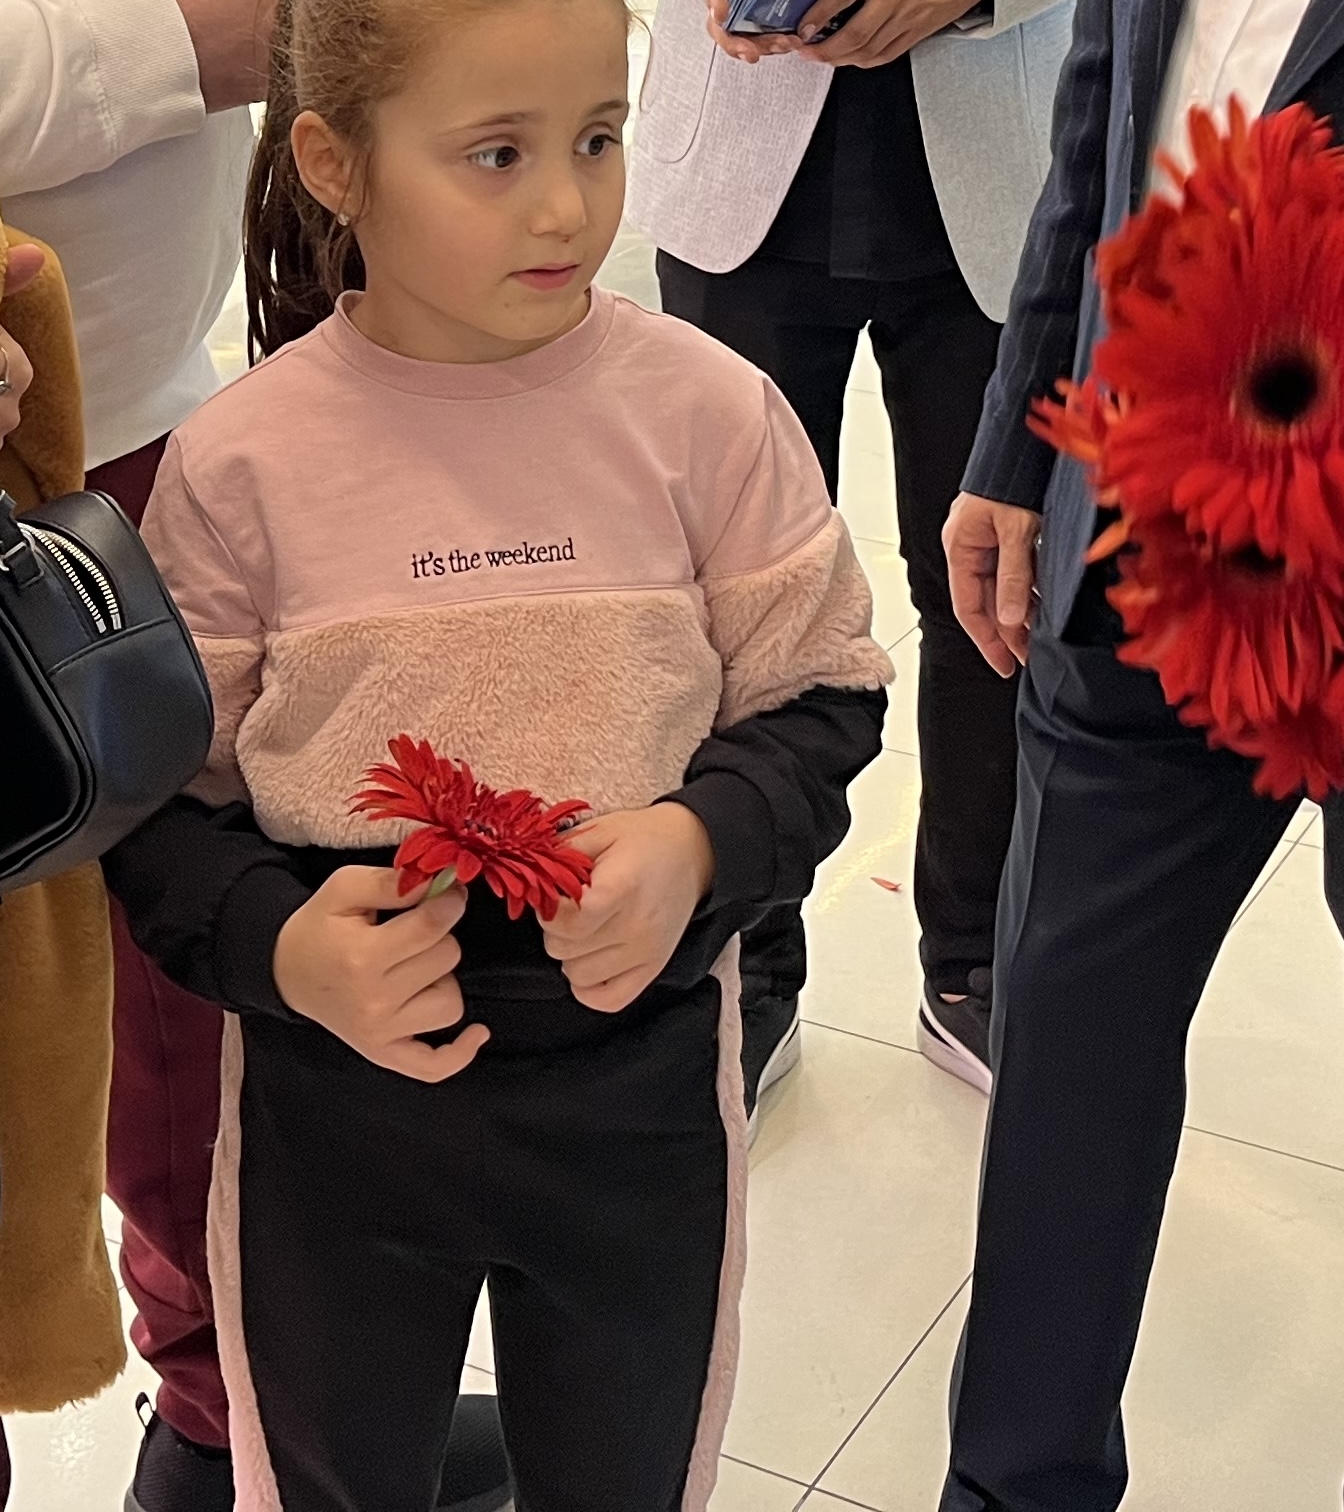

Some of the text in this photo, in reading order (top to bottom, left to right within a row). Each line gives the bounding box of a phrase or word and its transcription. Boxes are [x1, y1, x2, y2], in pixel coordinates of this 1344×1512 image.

[411, 537, 576, 578] it's the weekend
